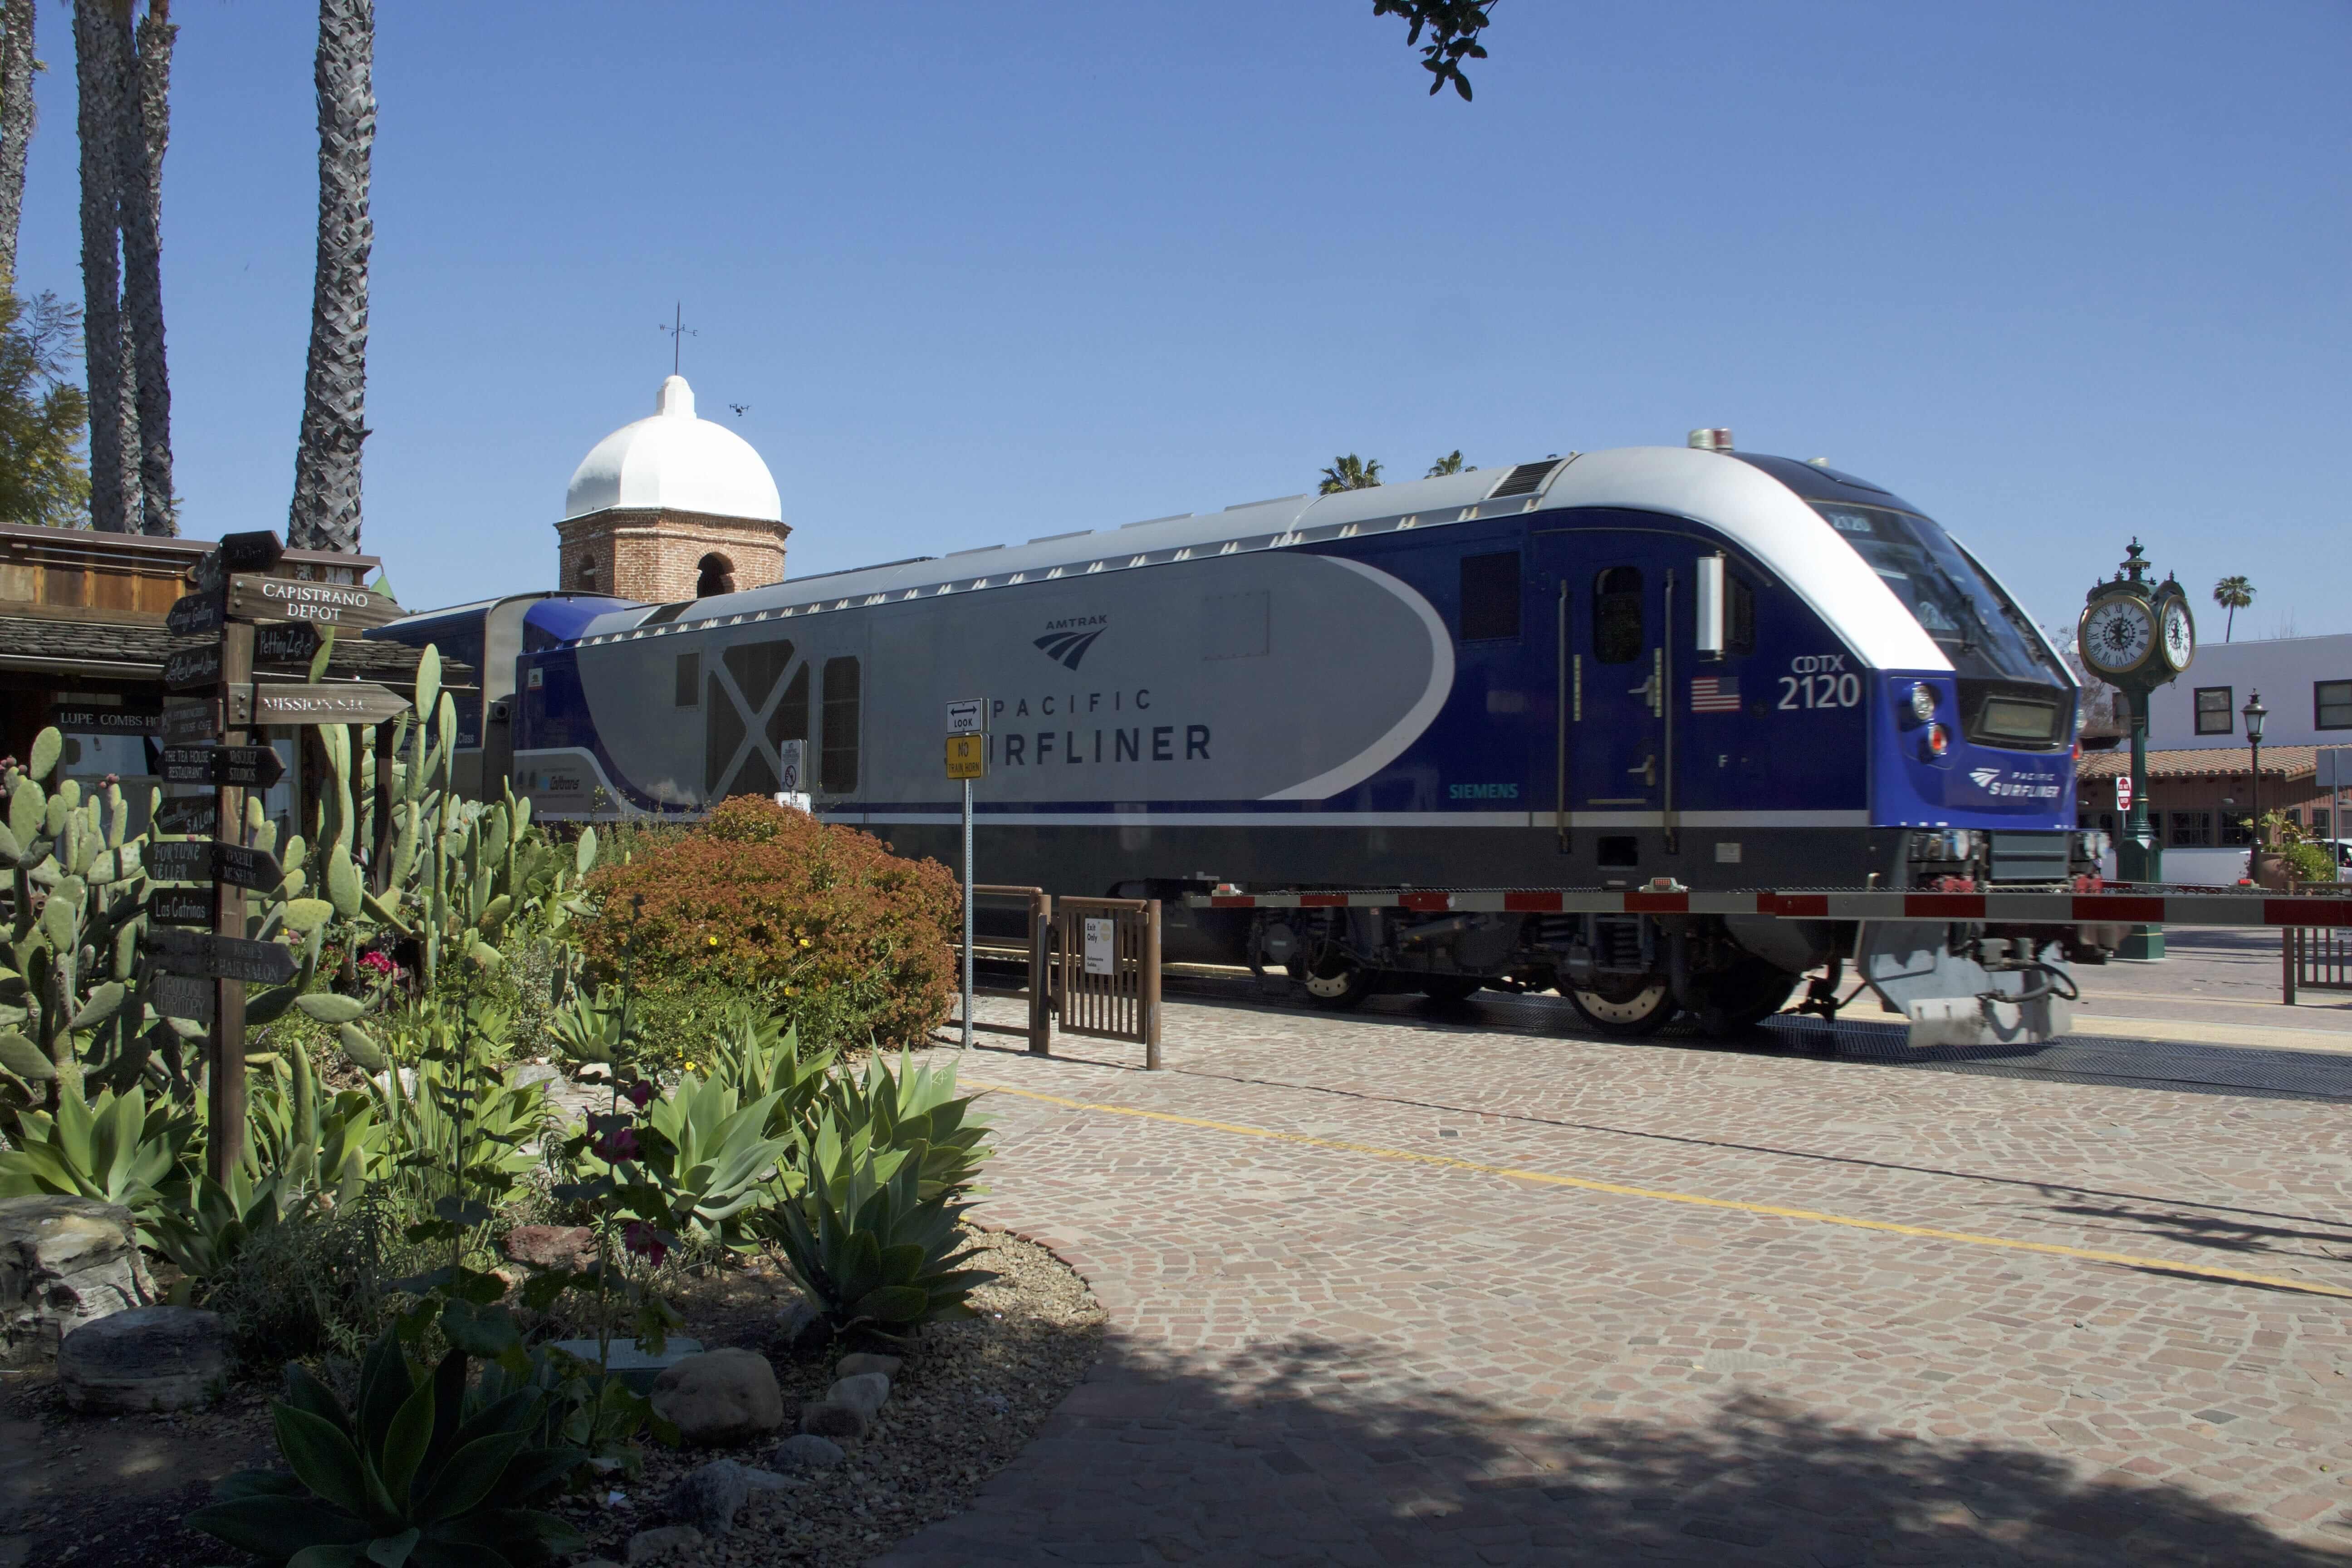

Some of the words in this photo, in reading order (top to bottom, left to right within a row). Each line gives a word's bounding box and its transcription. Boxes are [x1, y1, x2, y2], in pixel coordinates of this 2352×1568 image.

[263, 583, 368, 607] CAPISTRANO
[288, 603, 341, 621] DEPOT
[1046, 614, 1107, 630] AMTRAK
[259, 631, 285, 660] Petting
[1791, 654, 1845, 673] CDTX
[1777, 673, 1860, 710] 2120
[264, 697, 332, 710] MISSION
[993, 690, 1150, 718] PACIFIC
[60, 712, 94, 725] LUPE
[99, 714, 142, 726] COMBS
[954, 718, 972, 728] LOOK
[458, 732, 475, 744] Class
[990, 725, 1211, 766] RFLINER
[165, 750, 176, 762] THE
[177, 750, 188, 762] TEA
[189, 750, 209, 763] HOUSE
[958, 742, 969, 758] NO
[168, 766, 204, 779] RESTAURANT
[949, 763, 963, 774] TRAIN
[965, 762, 980, 773] HORN
[2011, 772, 2055, 781] PACIFIC
[1449, 784, 1519, 799] SIEMENS
[1988, 782, 2060, 798] SURFLINER
[186, 806, 215, 833] SALON
[154, 843, 200, 862] FORTUNE
[152, 864, 187, 880] TELLER
[155, 897, 170, 917] Las
[172, 897, 206, 918] Catrinas
[1087, 934, 1098, 943] Only
[219, 959, 241, 977] HAIR
[243, 962, 279, 981] SALON
